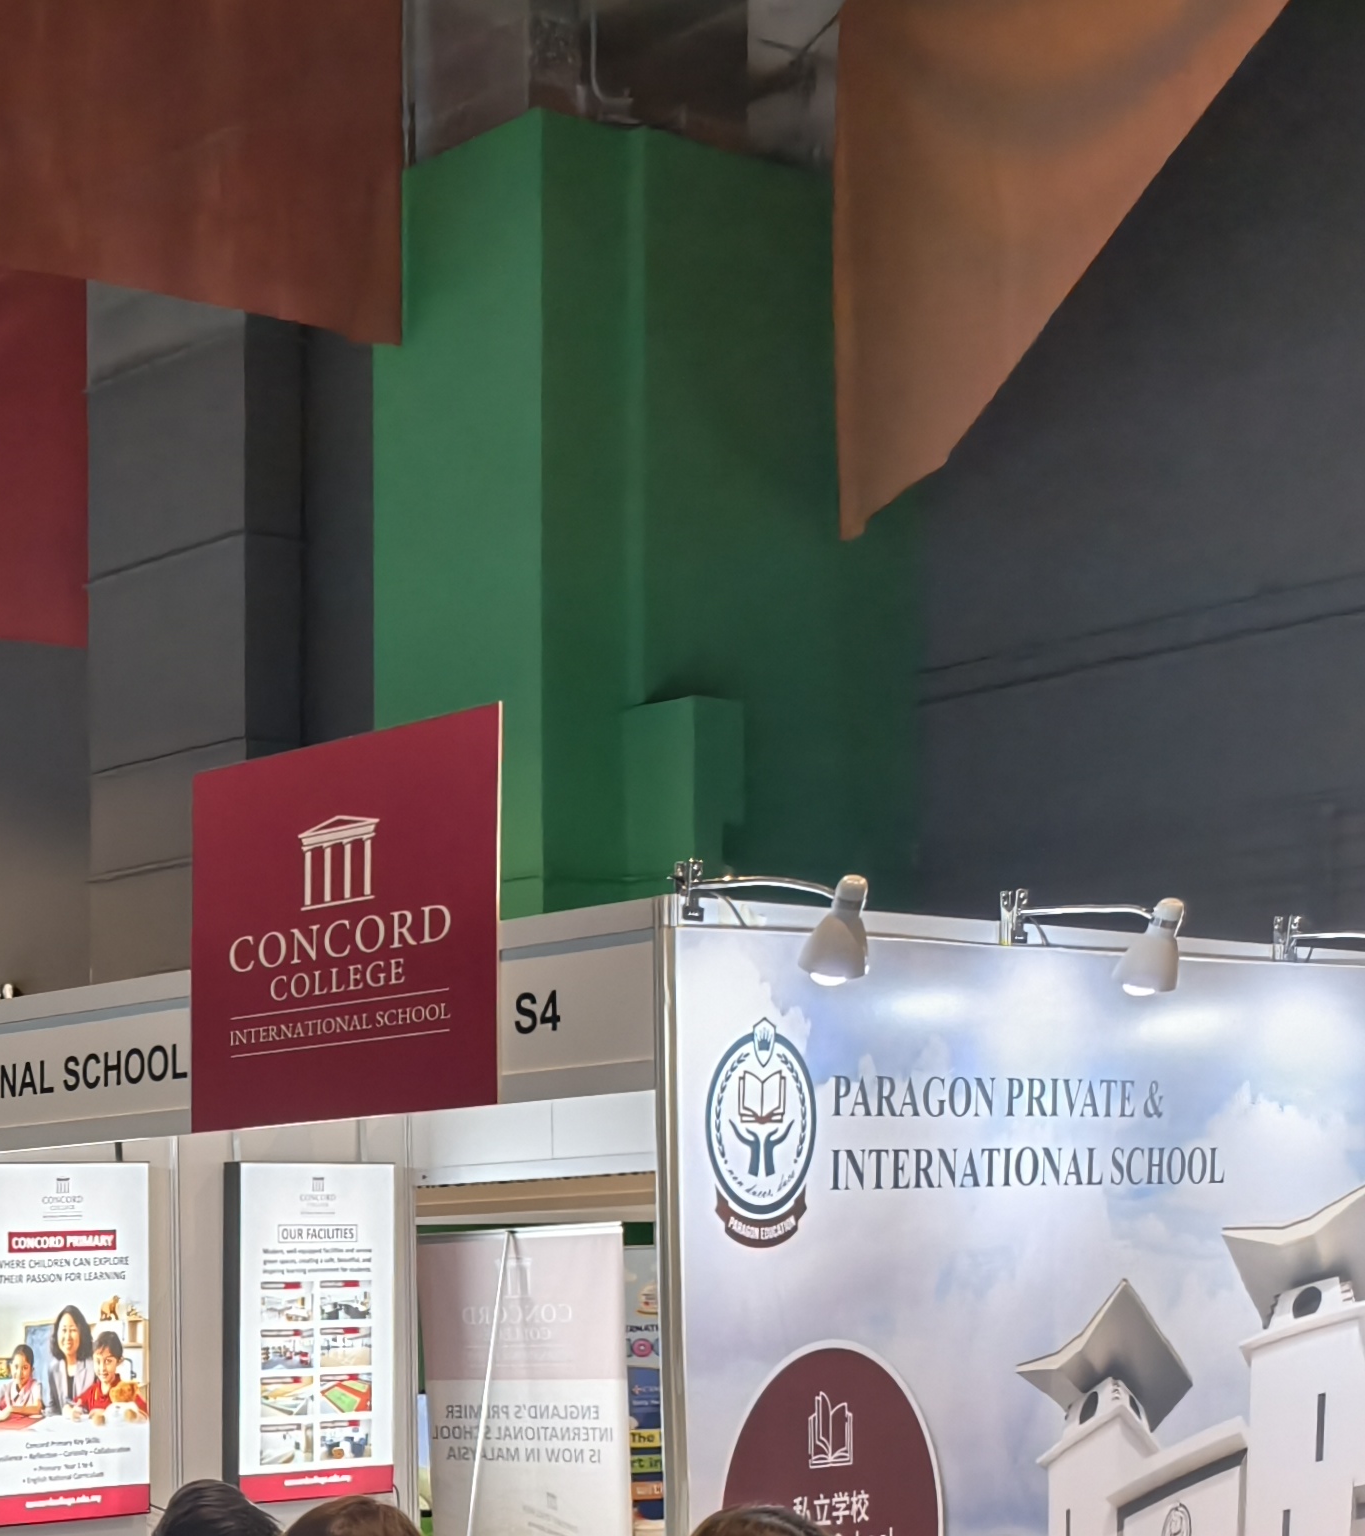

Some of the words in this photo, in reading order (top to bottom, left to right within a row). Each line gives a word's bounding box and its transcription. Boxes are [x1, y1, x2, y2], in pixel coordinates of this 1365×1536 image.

[228, 904, 451, 973] CONCORD
[270, 958, 405, 1001] COLLEGE
[230, 1011, 372, 1046] INTERNATIONAL
[375, 1003, 451, 1029] SCHOOL
[514, 990, 561, 1034] S4
[63, 1043, 188, 1091] SCHOOL
[830, 1074, 996, 1118] PARAGON
[1005, 1078, 1135, 1118] PRIVATE
[1143, 1079, 1164, 1119] &
[829, 1146, 1103, 1191] INTERNATIONAL
[1110, 1146, 1225, 1186] SCHOOL
[11, 1236, 65, 1249] CONCORD
[66, 1234, 114, 1248] PRIMARY
[281, 1228, 304, 1240] OUR
[306, 1227, 354, 1239] FACILITIES
[728, 1216, 759, 1240] PARAGON
[26, 1273, 62, 1283] PASSION
[65, 1272, 82, 1281] FOR
[84, 1271, 126, 1281] LEARNING
[28, 1258, 71, 1268] CHILDREN
[73, 1257, 91, 1267] CAN
[93, 1256, 129, 1266] EXPLORE
[630, 1432, 655, 1443] The
[793, 1490, 869, 1526] 私立学校
